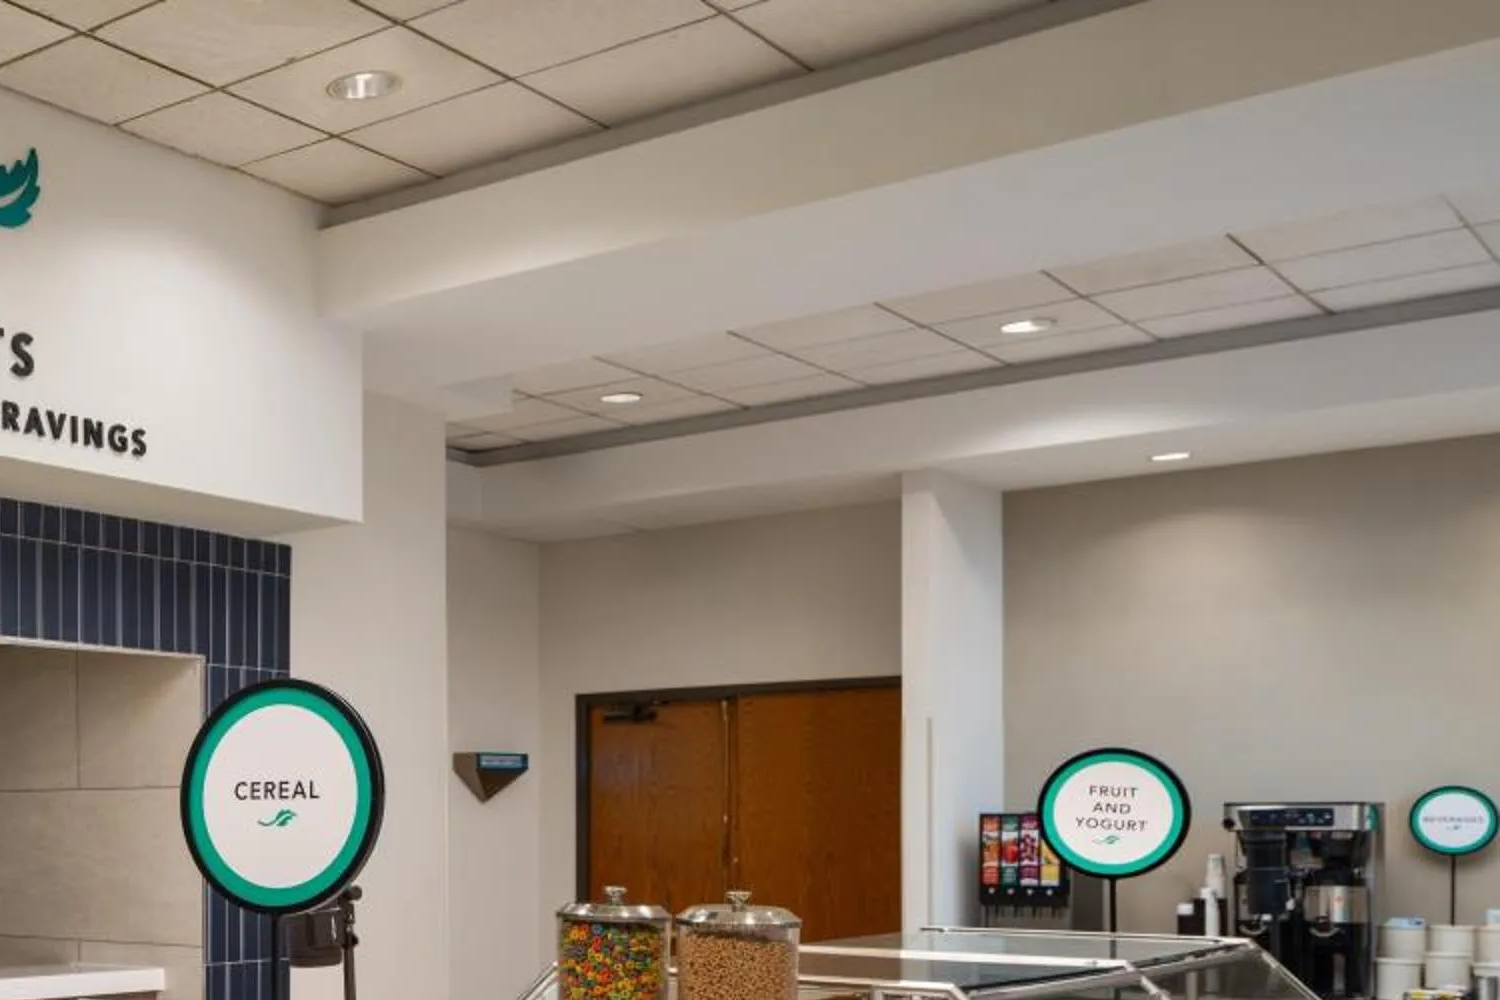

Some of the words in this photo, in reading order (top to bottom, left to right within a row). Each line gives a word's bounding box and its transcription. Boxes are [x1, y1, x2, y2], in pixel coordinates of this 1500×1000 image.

[234, 780, 320, 801] CEREAL
[1088, 785, 1138, 798] FRUIT
[1092, 802, 1131, 814] AND
[1075, 817, 1148, 831] YOGURT
